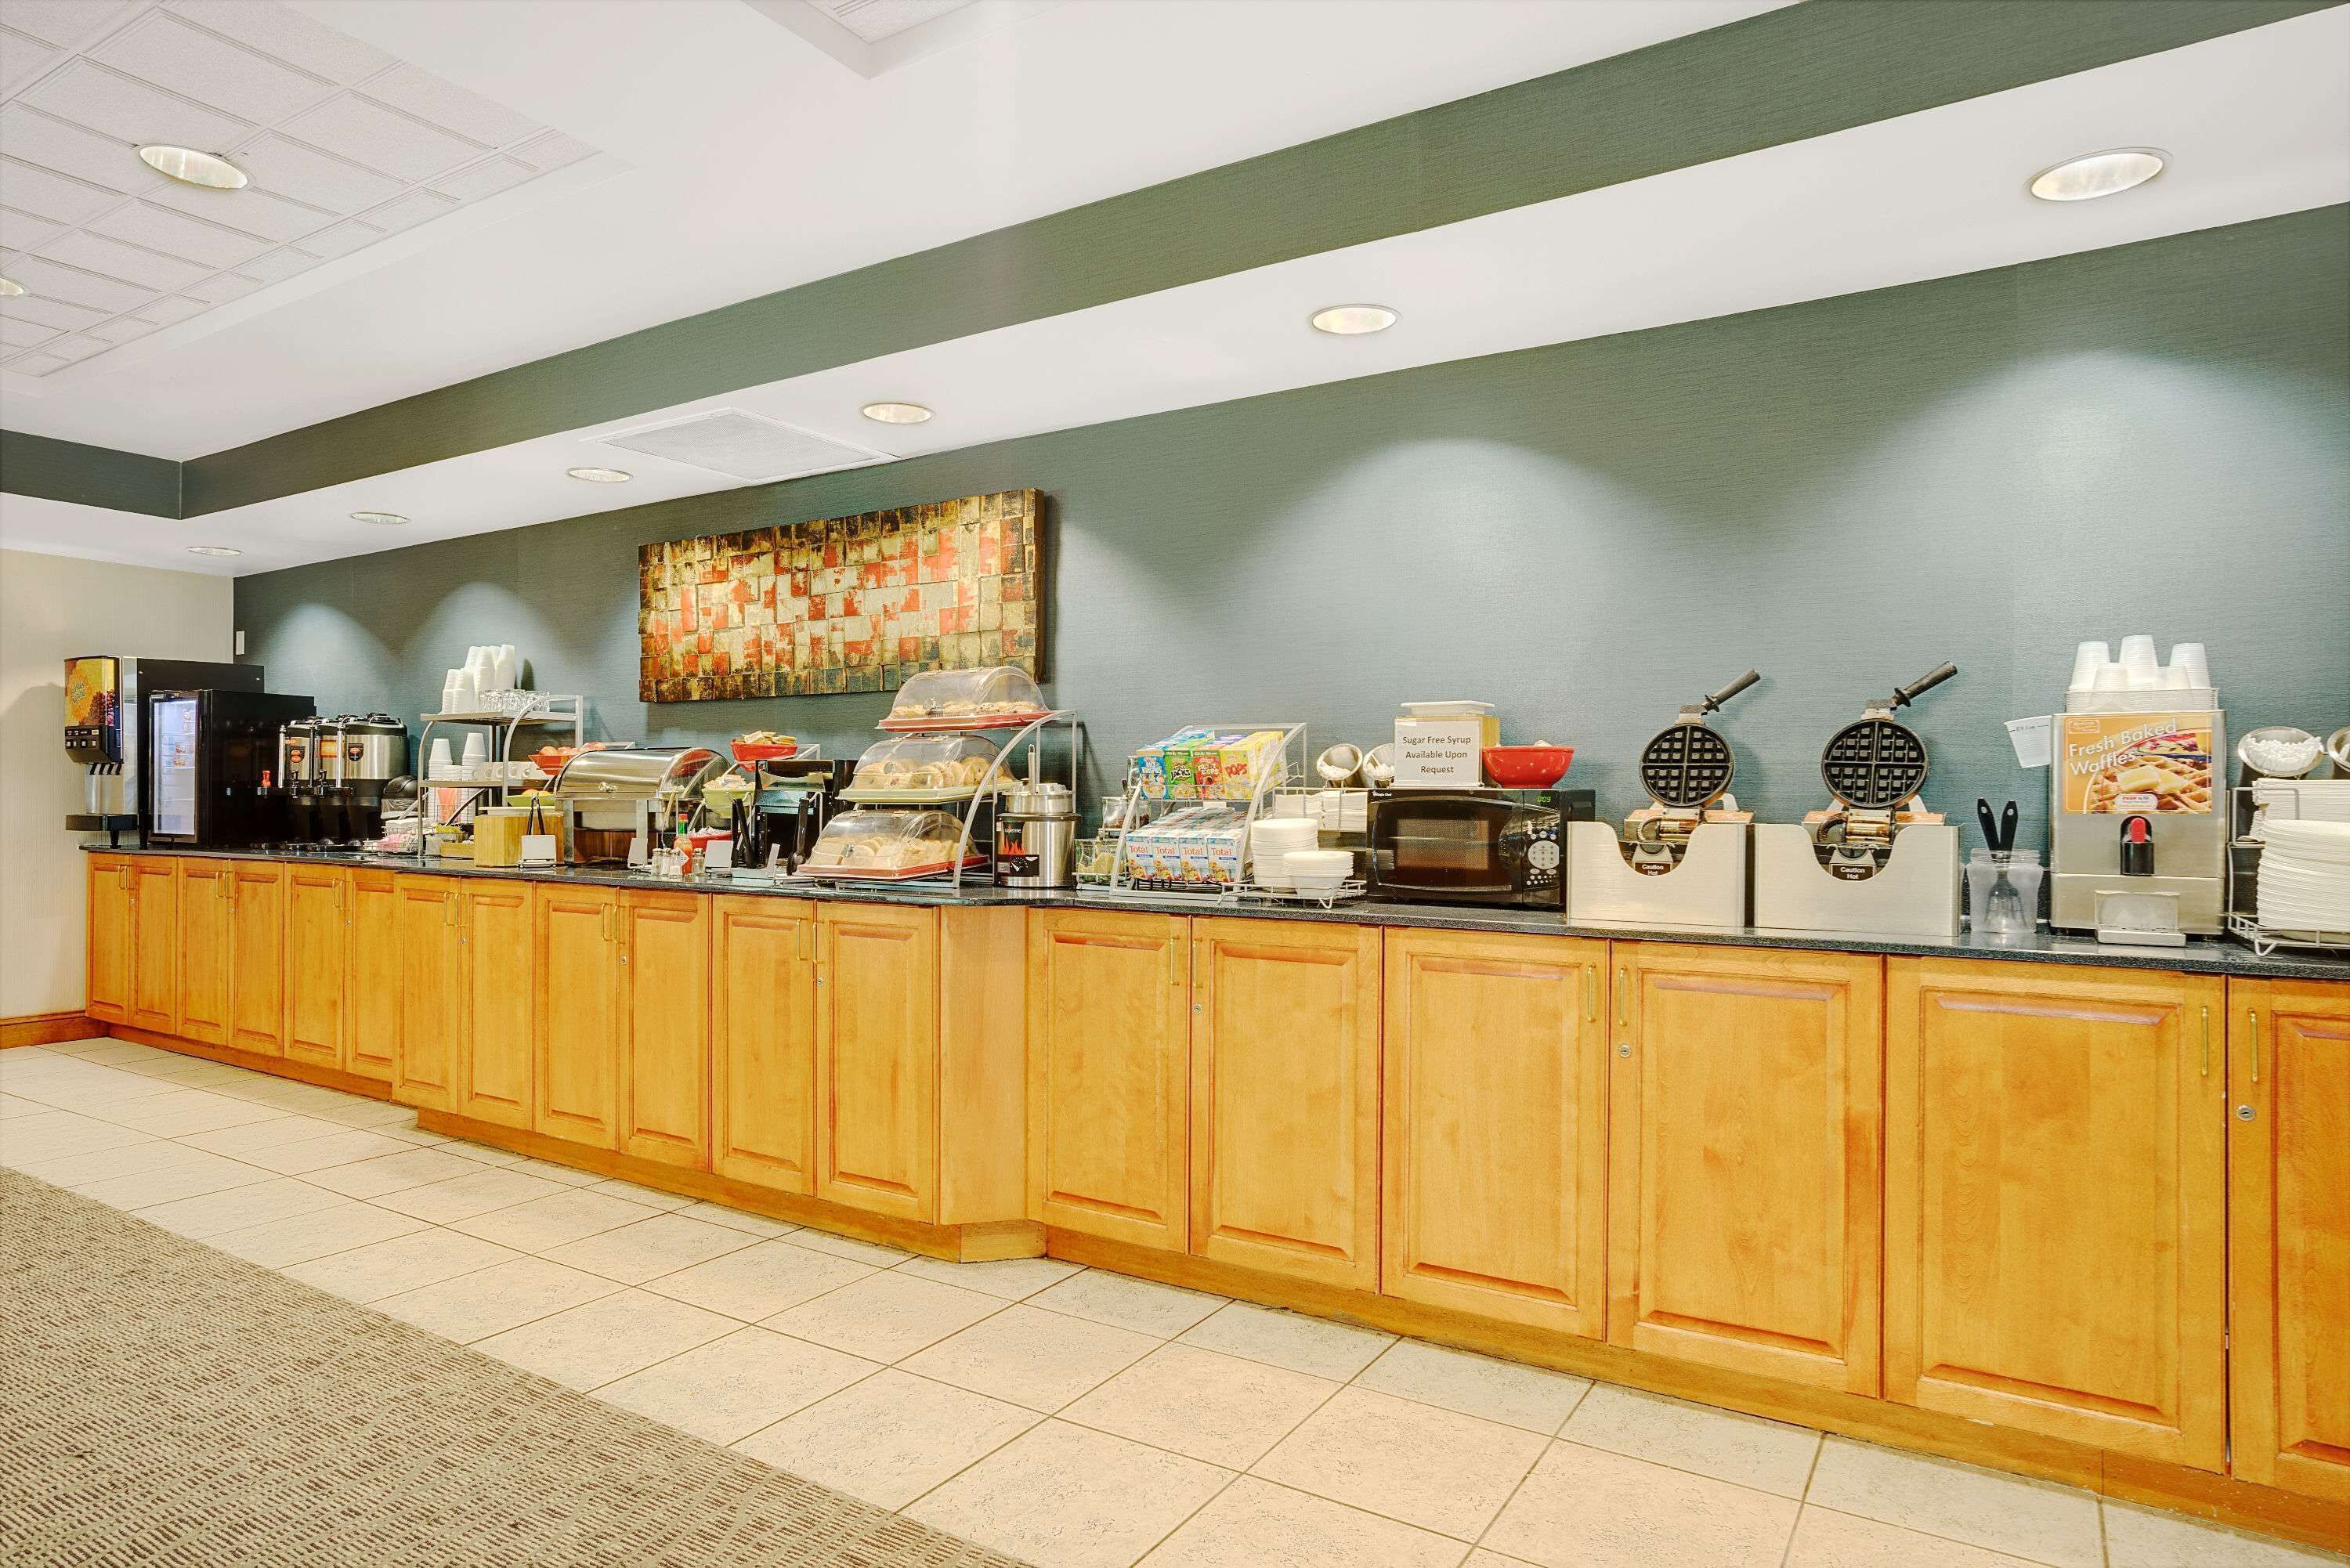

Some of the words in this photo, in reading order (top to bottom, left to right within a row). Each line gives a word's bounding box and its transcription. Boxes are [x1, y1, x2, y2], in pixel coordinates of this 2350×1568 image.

[1402, 736, 1426, 746] Sugar
[1447, 735, 1471, 745] Syrup
[2069, 735, 2114, 757] Fresh
[2121, 717, 2177, 745] Baked
[1405, 750, 1443, 759] Available
[1444, 751, 1467, 760] Upon
[2069, 750, 2136, 775] Waffles
[1420, 765, 1455, 775] Request
[1182, 847, 1203, 855] Total
[1210, 847, 1231, 856] Total
